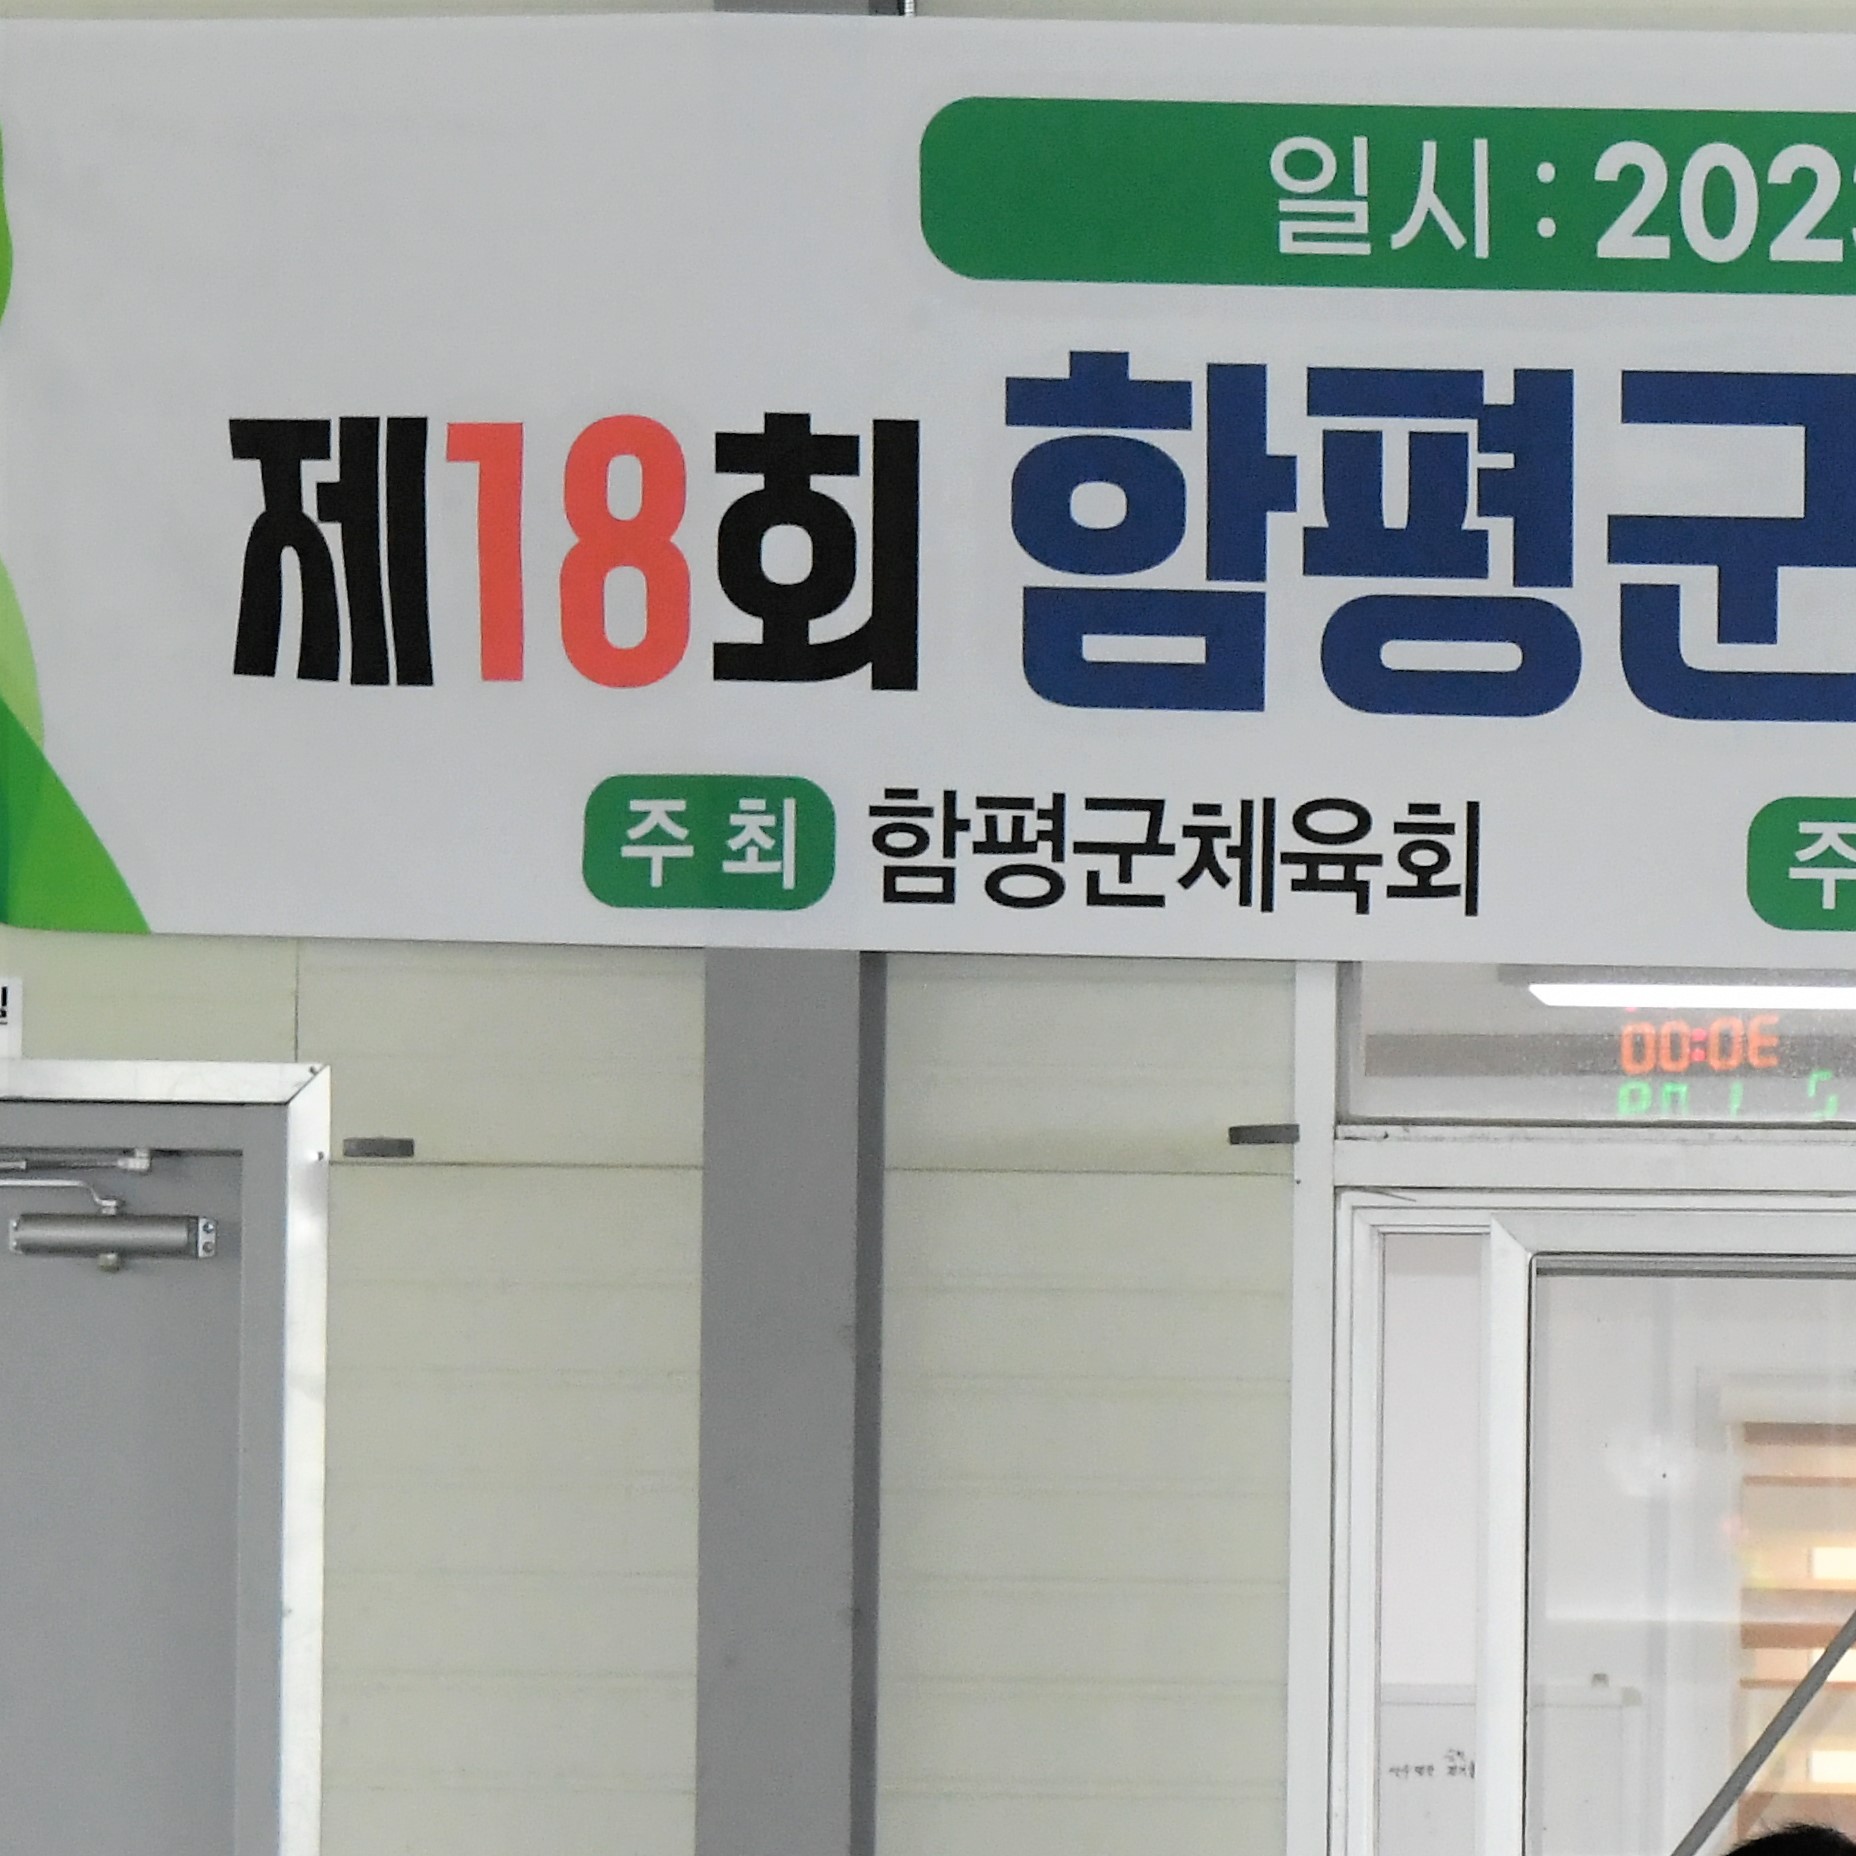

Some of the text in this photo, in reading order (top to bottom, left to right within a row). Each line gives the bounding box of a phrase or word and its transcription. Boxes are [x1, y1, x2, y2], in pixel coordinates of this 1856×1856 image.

[1269, 136, 1489, 259] 일시
[227, 410, 920, 692] 제18회
[867, 786, 1481, 918] 함평군체육회
